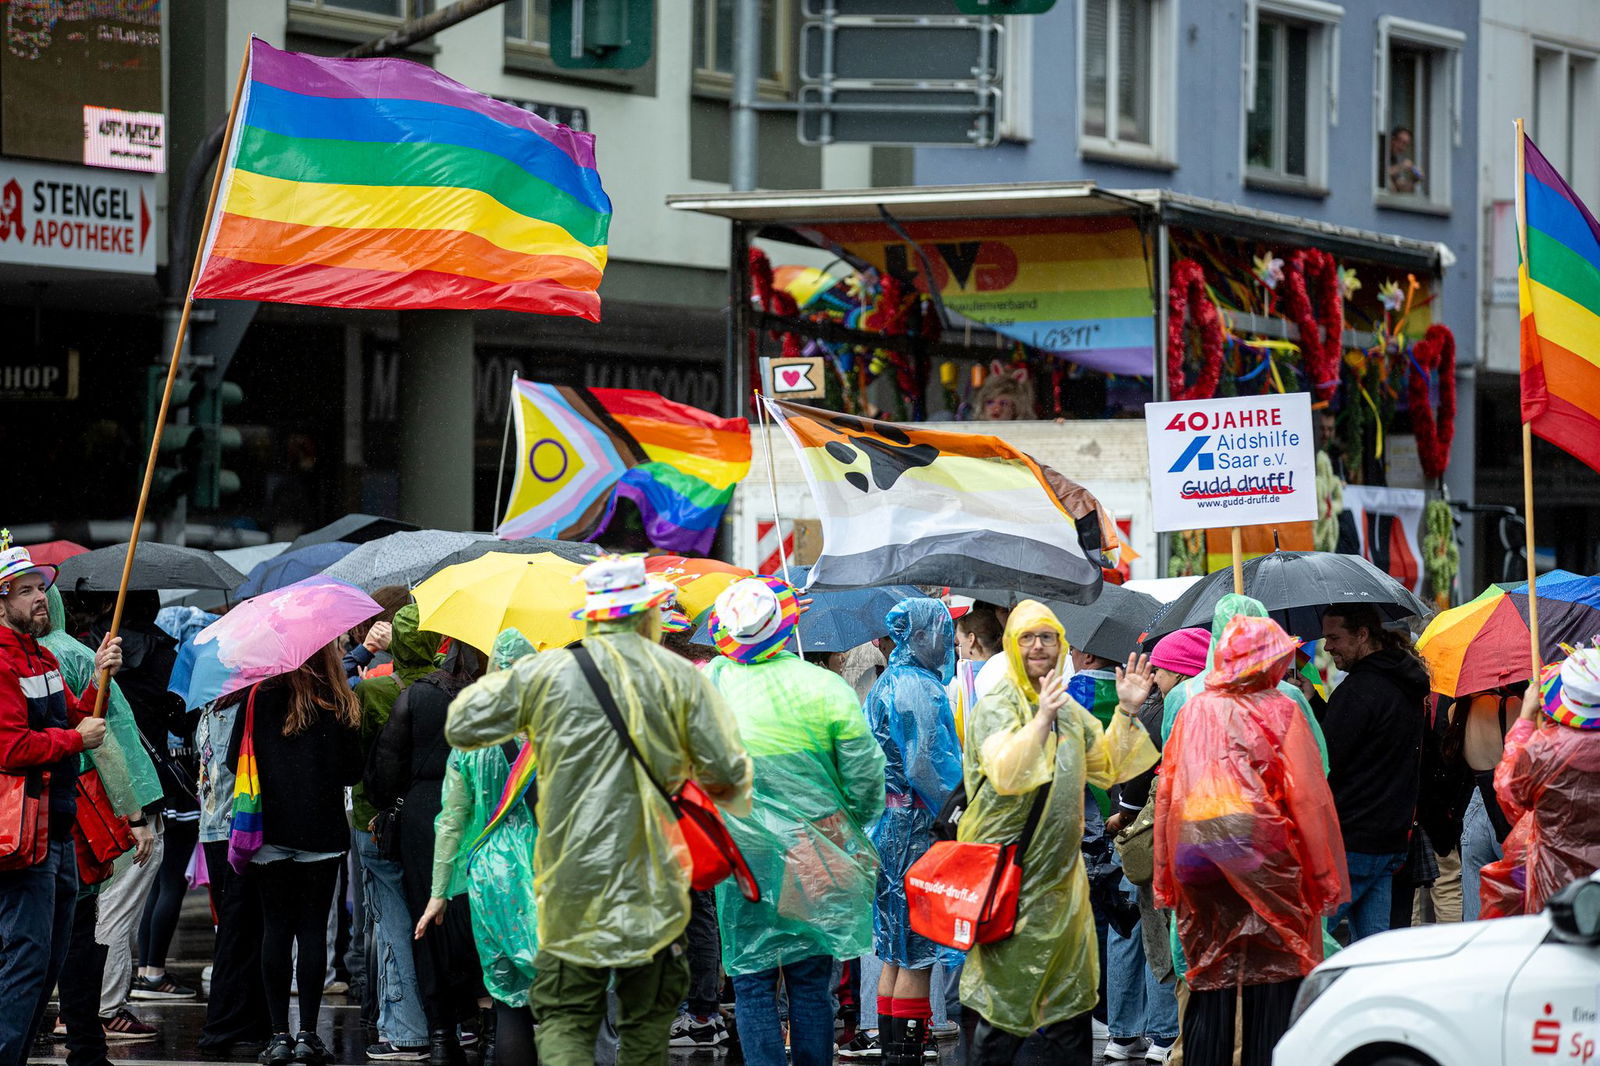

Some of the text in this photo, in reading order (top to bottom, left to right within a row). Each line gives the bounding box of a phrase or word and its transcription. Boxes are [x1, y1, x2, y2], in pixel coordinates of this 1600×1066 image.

[33, 179, 134, 221] STENGEL
[33, 218, 134, 254] APOTHEKE
[0, 366, 59, 389] HOP
[1165, 408, 1282, 431] 40 JAHRE
[1217, 430, 1299, 451] Aidshilfe
[1218, 452, 1287, 470] Saar e.V.
[1182, 471, 1293, 495] Gudd druff!
[1197, 495, 1280, 508] www.gudd-druff.de
[909, 877, 979, 904] www.gudd-druff.de
[1572, 1006, 1598, 1022] Eine
